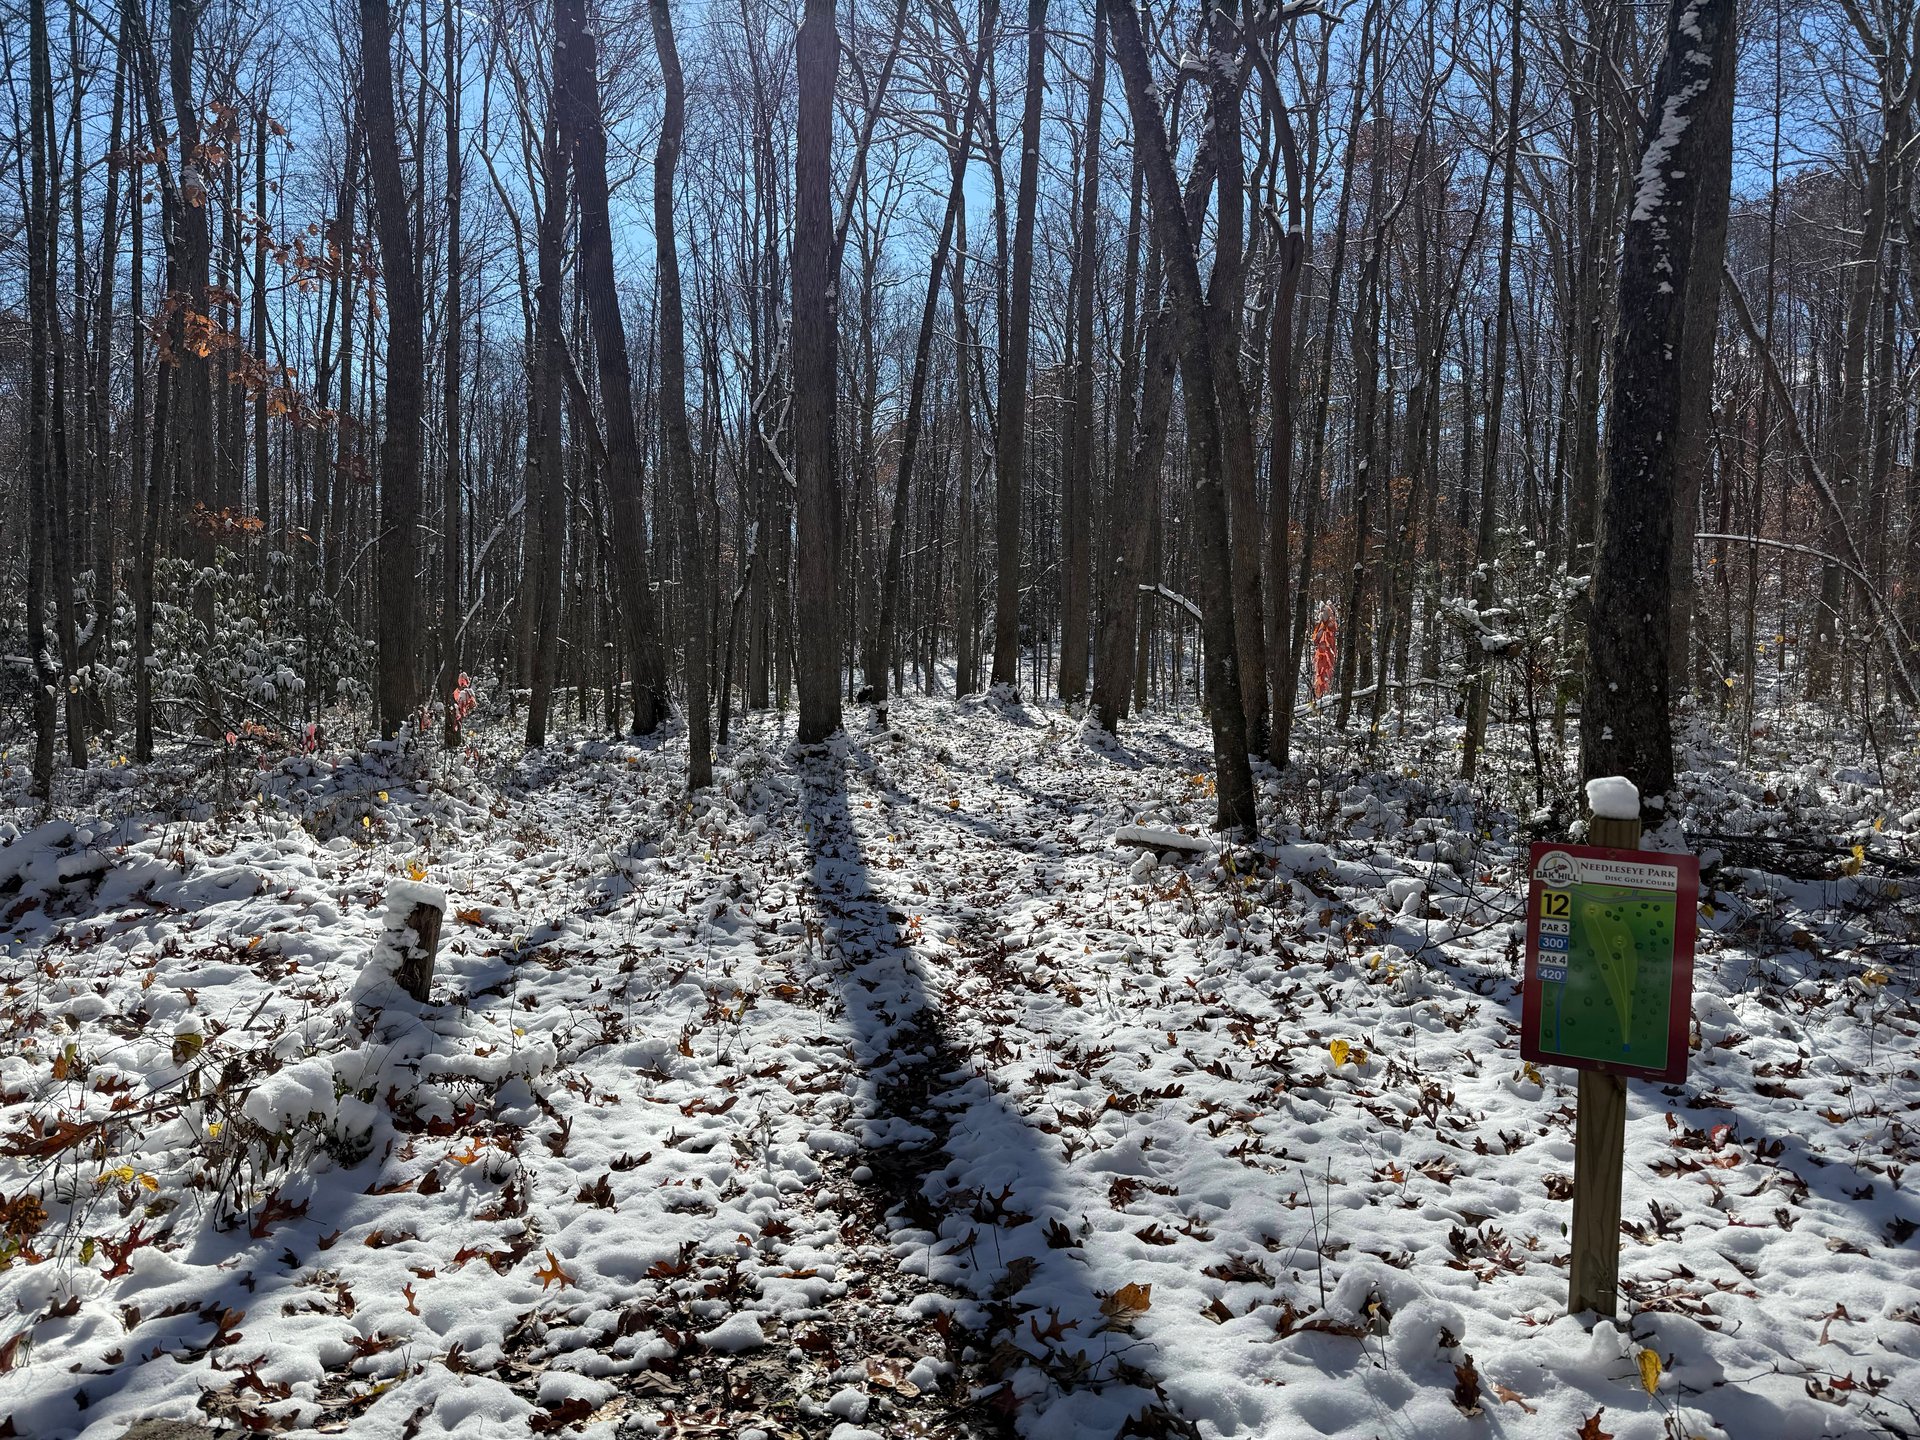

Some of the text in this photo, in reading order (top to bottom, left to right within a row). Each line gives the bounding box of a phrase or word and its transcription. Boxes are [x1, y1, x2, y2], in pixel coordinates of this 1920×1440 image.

[1536, 870, 1579, 882] OAK HILL
[1580, 862, 1676, 879] NEEDLESEYE PARK
[1646, 880, 1675, 888] COURSE
[1543, 893, 1569, 916] 12
[1541, 922, 1568, 933] PAR 3
[1540, 954, 1566, 965] PAR 4
